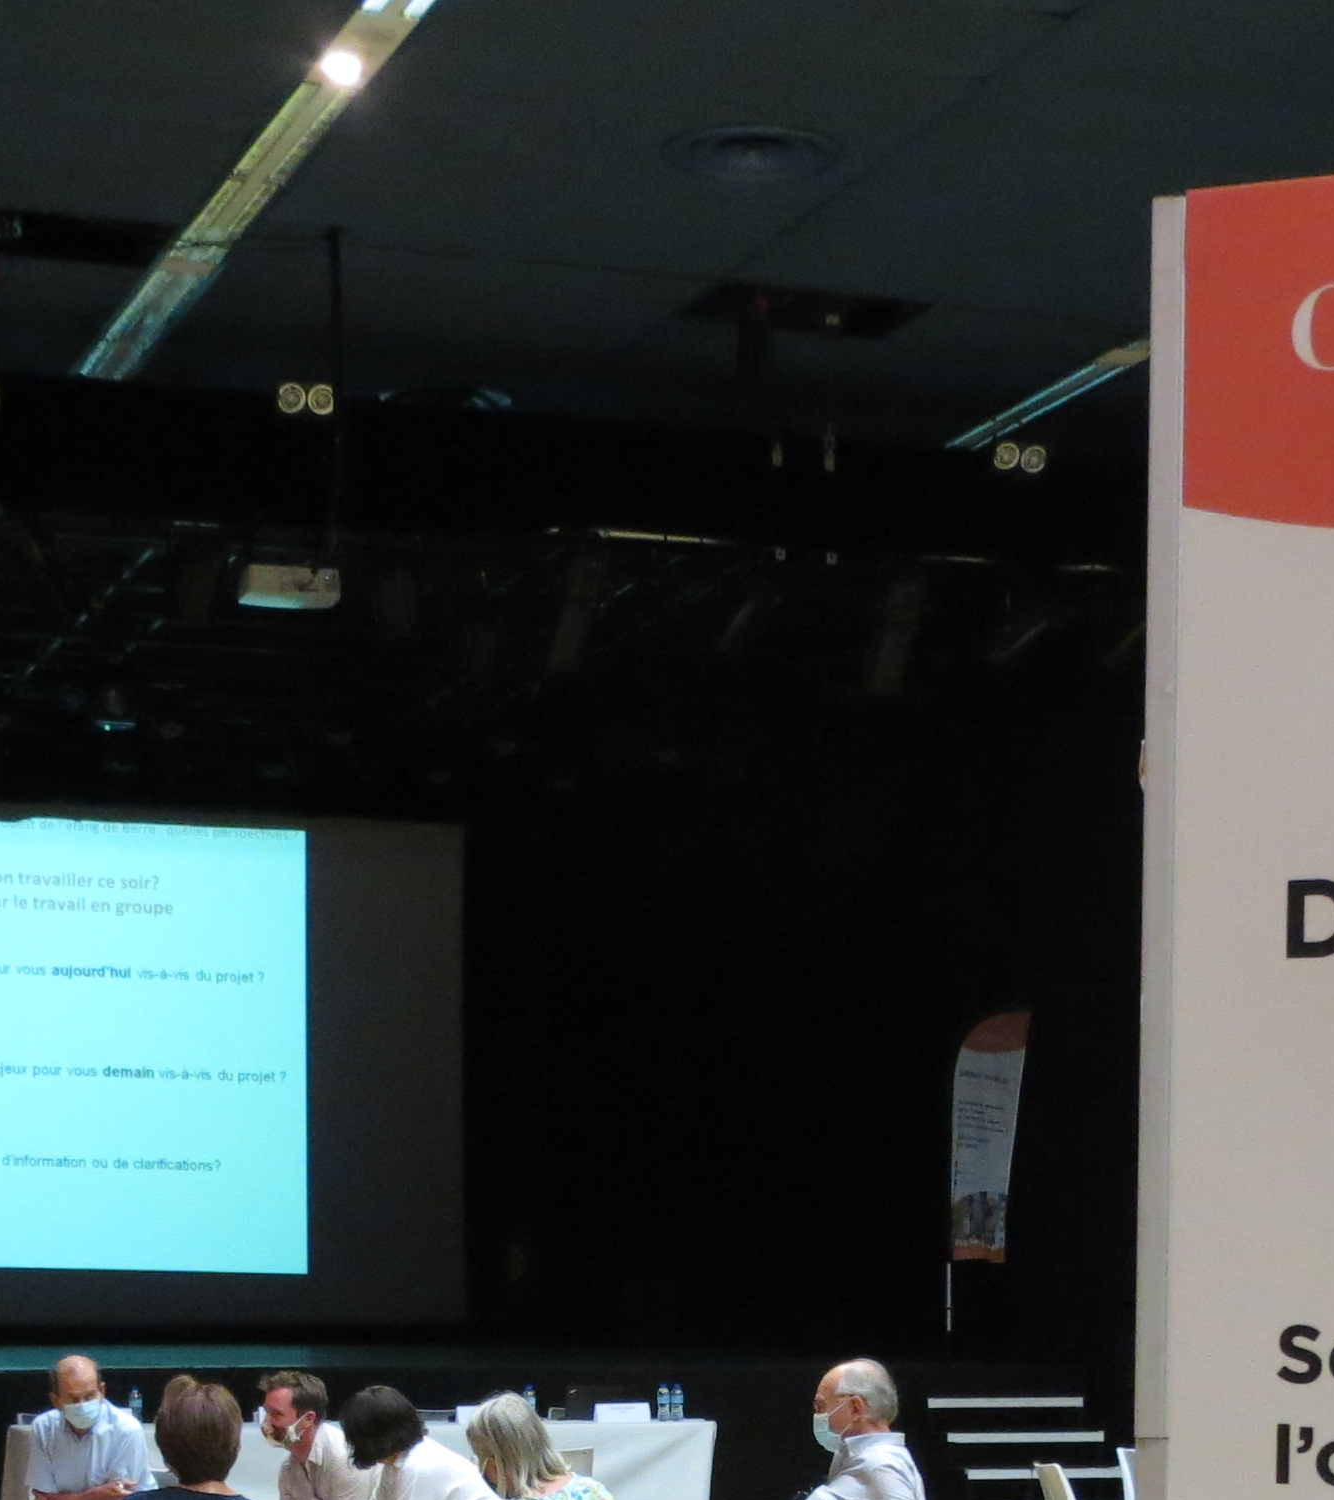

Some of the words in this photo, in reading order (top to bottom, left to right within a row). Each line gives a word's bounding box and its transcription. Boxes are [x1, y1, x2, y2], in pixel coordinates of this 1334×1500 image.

[18, 870, 93, 888] travailler
[98, 877, 116, 889] ce
[14, 894, 28, 909] le
[33, 895, 86, 912] travail
[91, 901, 111, 913] en
[115, 901, 174, 917] groupe
[16, 965, 47, 976] vous
[195, 969, 212, 982] du
[216, 970, 255, 985] projet
[32, 1065, 62, 1078] pour
[66, 1067, 98, 1077] vous
[103, 1065, 154, 1079] demain
[217, 1069, 233, 1082] du
[237, 1070, 275, 1085] projet
[92, 1158, 108, 1169] ou
[112, 1156, 129, 1170] de
